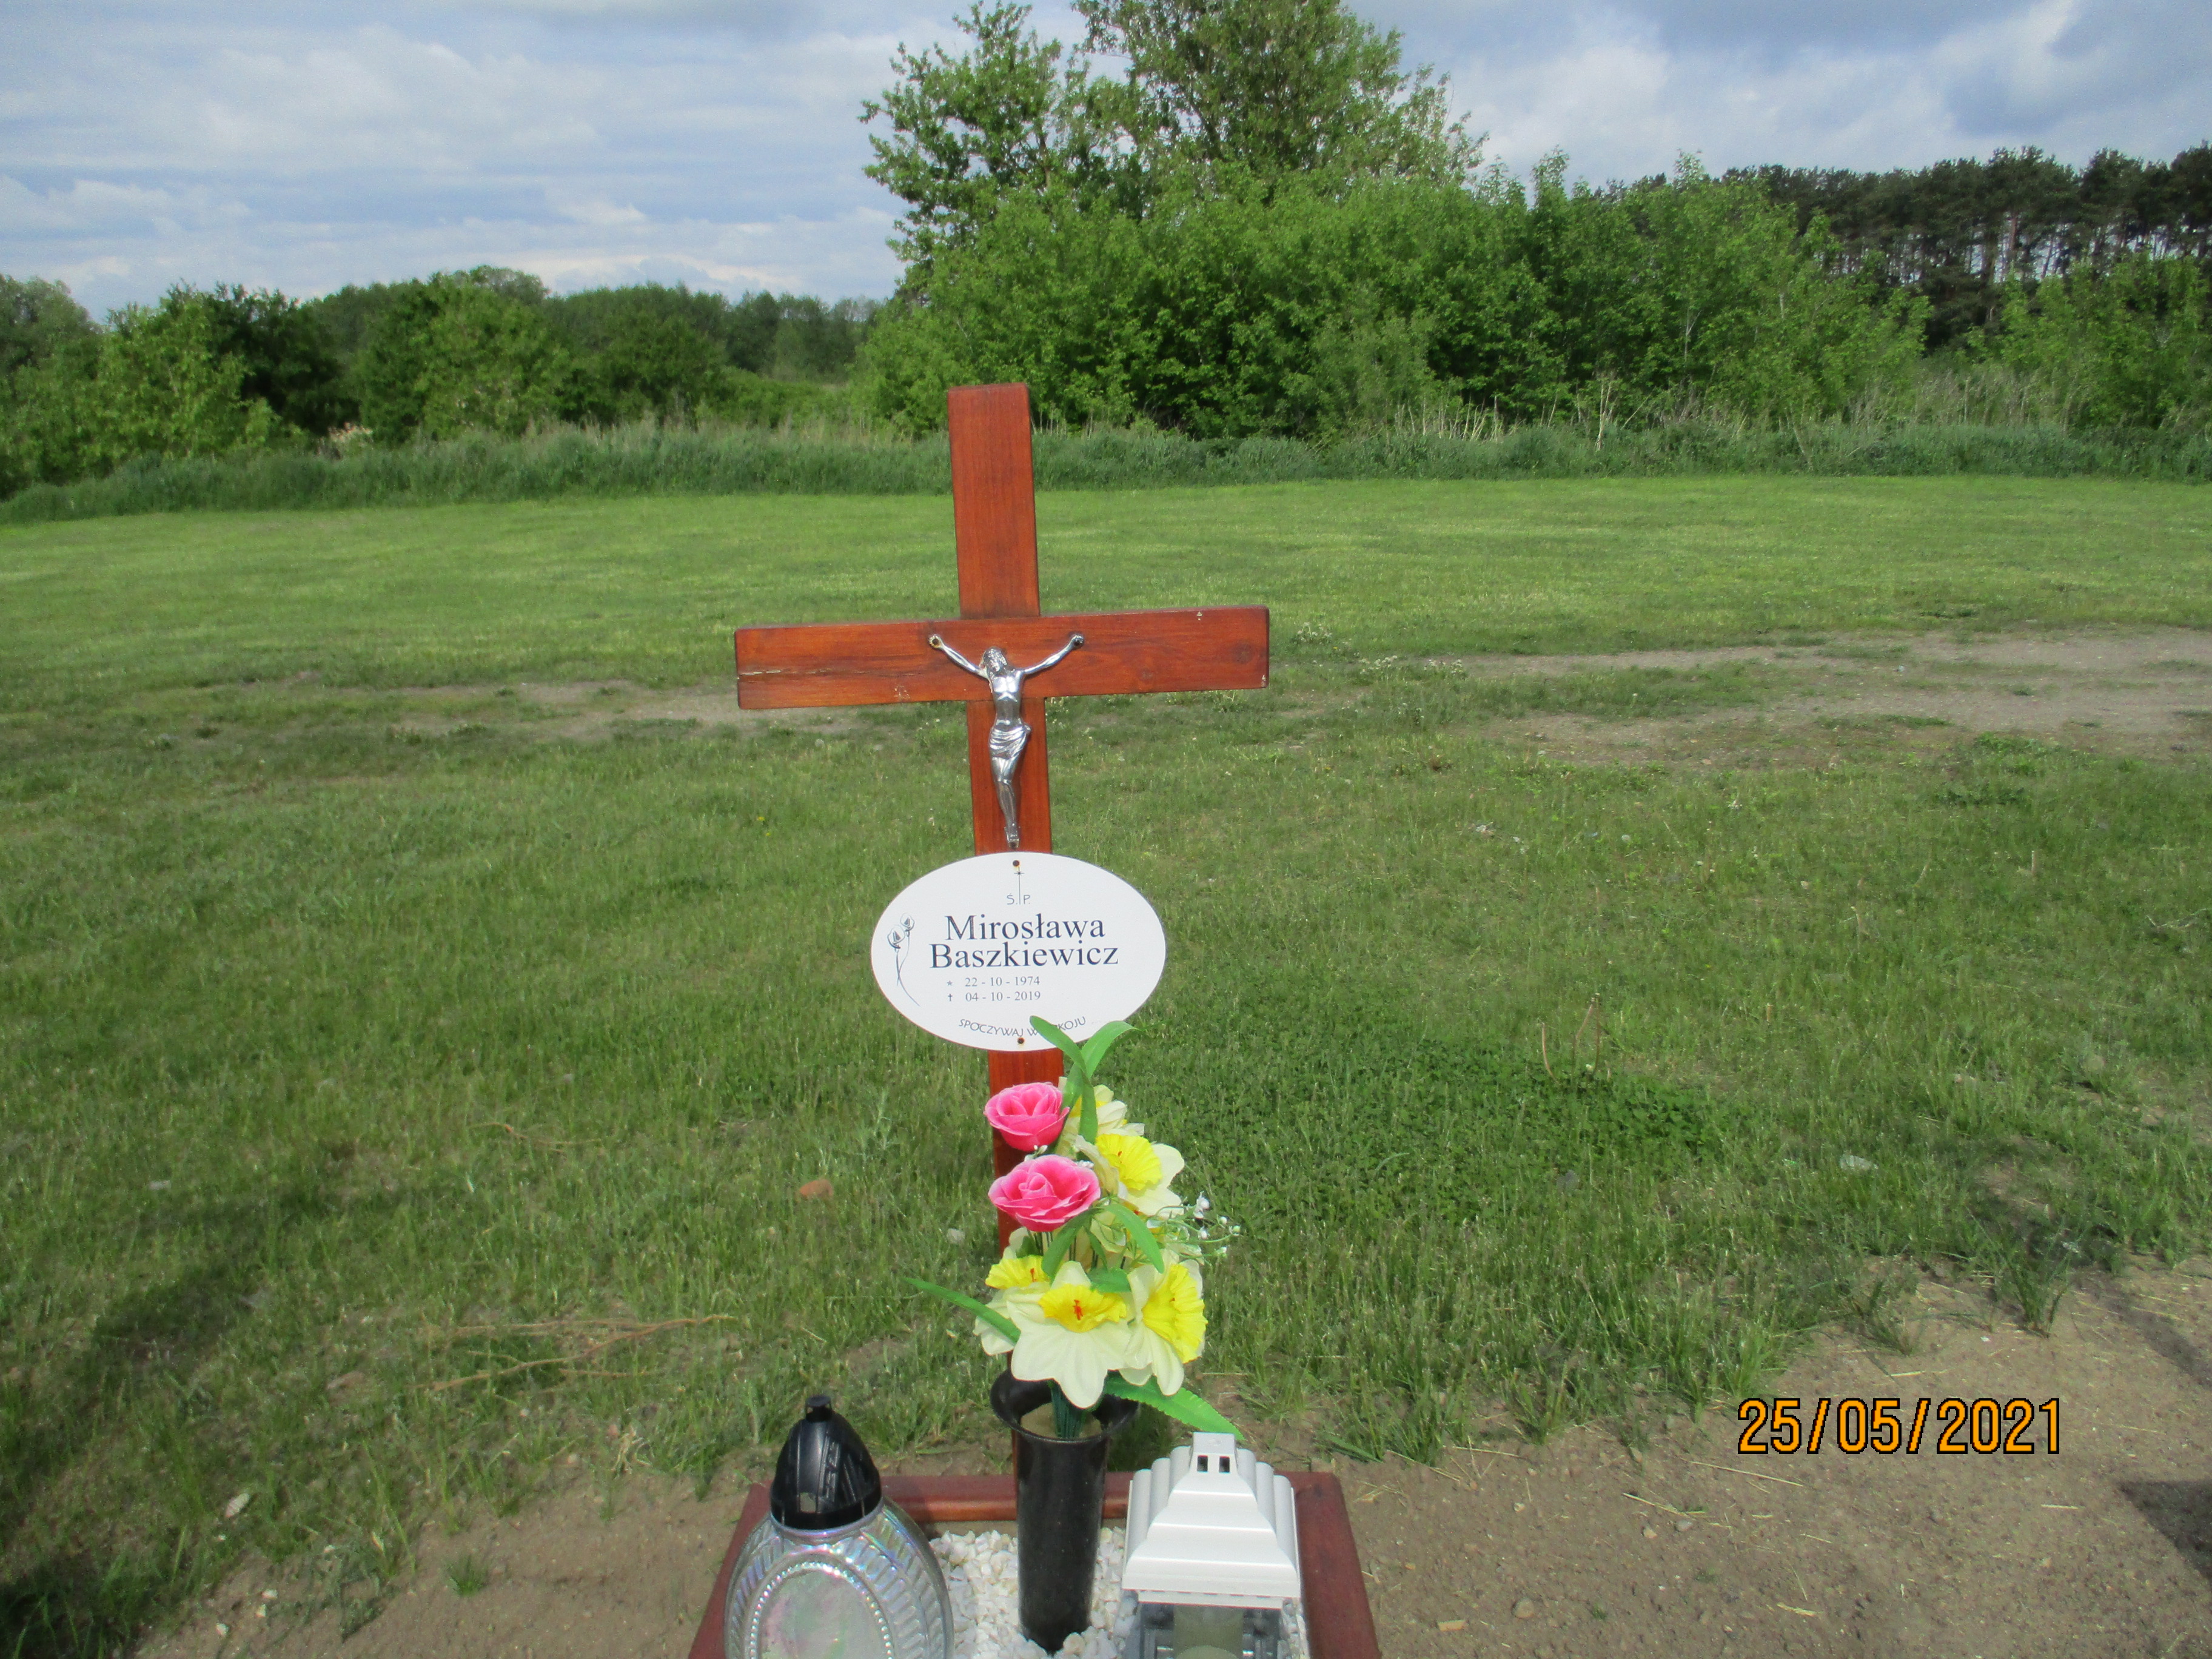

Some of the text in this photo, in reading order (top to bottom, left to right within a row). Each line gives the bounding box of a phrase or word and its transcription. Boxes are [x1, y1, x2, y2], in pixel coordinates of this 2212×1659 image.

[945, 913, 1105, 941] Mirosława
[930, 939, 1119, 969] Baszkiewicz
[965, 977, 977, 987] 22
[990, 977, 1002, 986] 10
[1015, 976, 1040, 986] 1974
[965, 992, 979, 1002] 04
[991, 991, 1003, 1001] 10
[1014, 991, 1041, 1001] 2019
[959, 1019, 1024, 1037] SPOCZYWAJ
[1027, 1028, 1038, 1036] W
